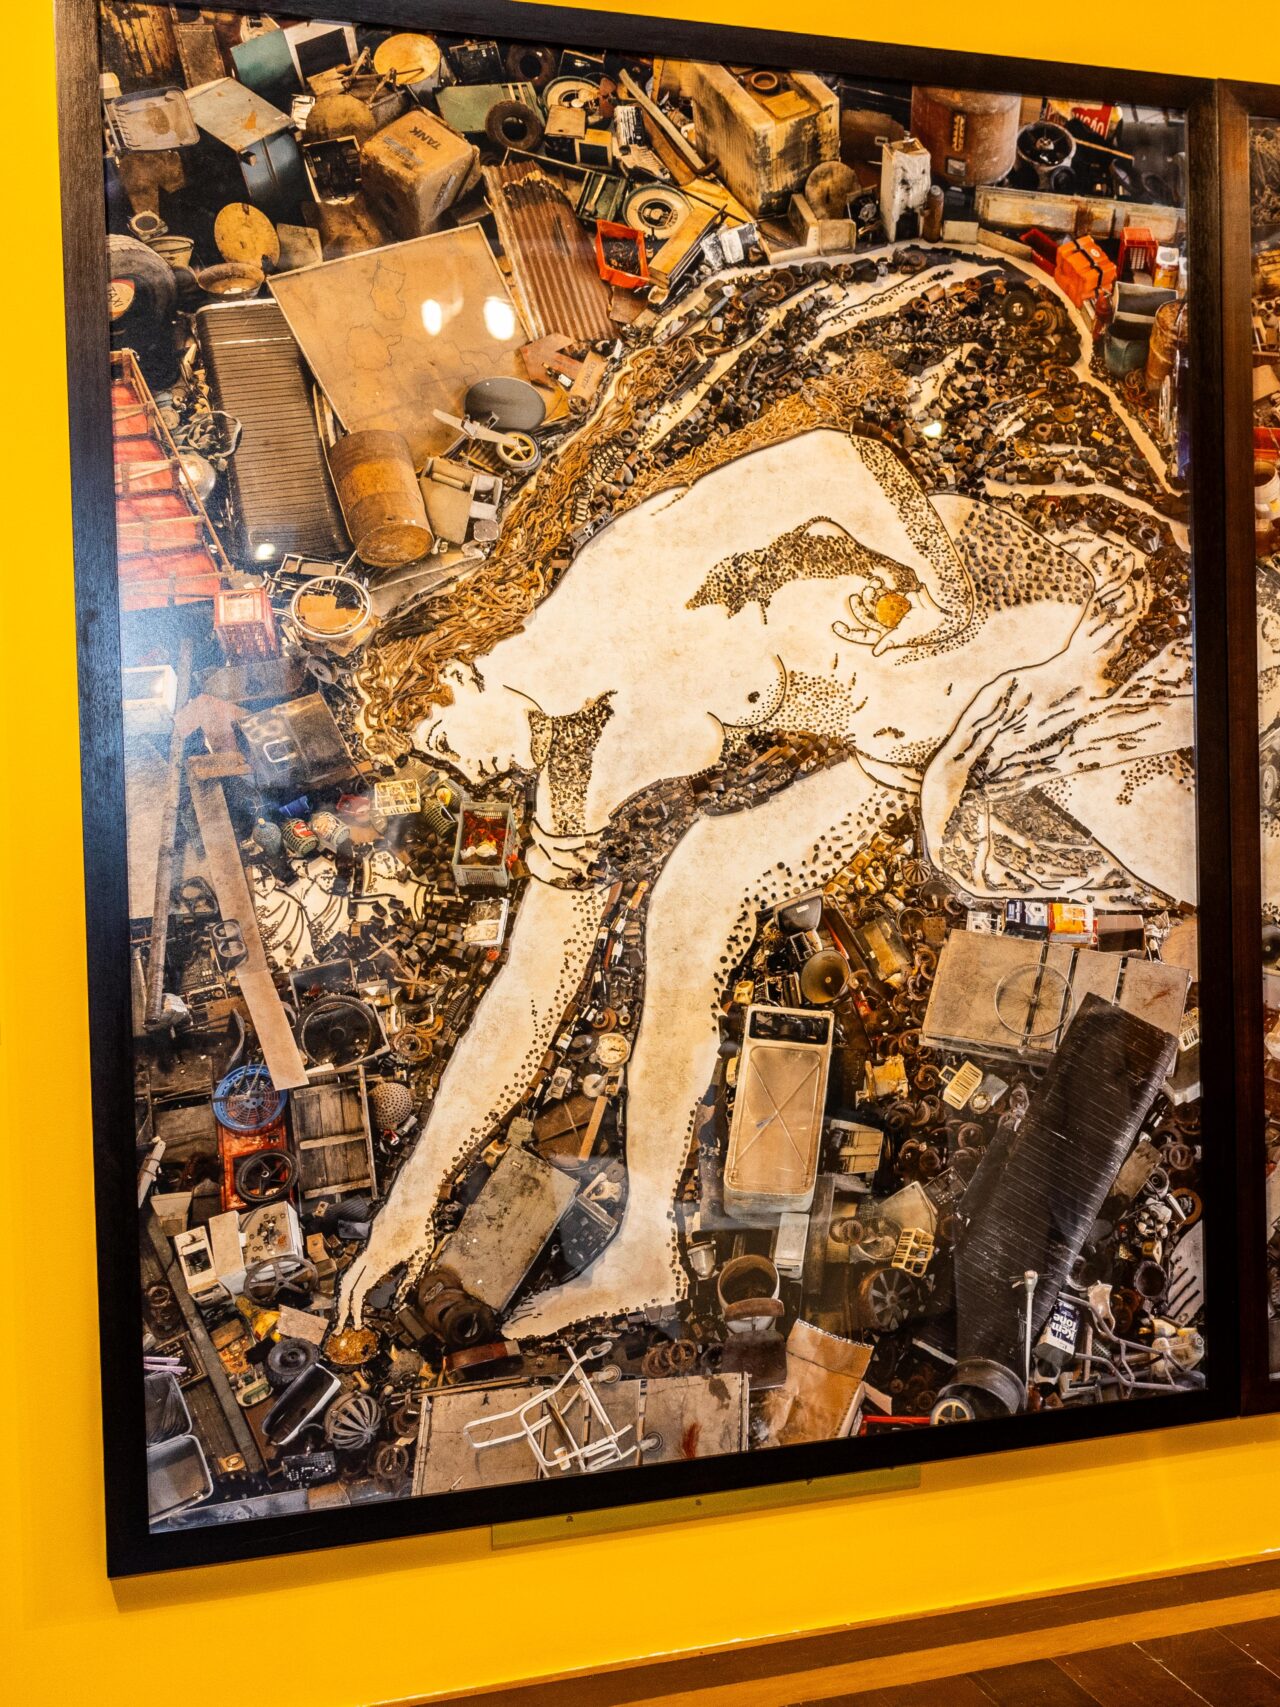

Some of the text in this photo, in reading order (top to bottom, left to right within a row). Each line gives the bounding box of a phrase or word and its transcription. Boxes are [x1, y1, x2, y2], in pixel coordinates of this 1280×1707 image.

[409, 127, 441, 150] TANK
[1051, 1321, 1075, 1341] Kem
[1053, 1313, 1076, 1332] Tone
